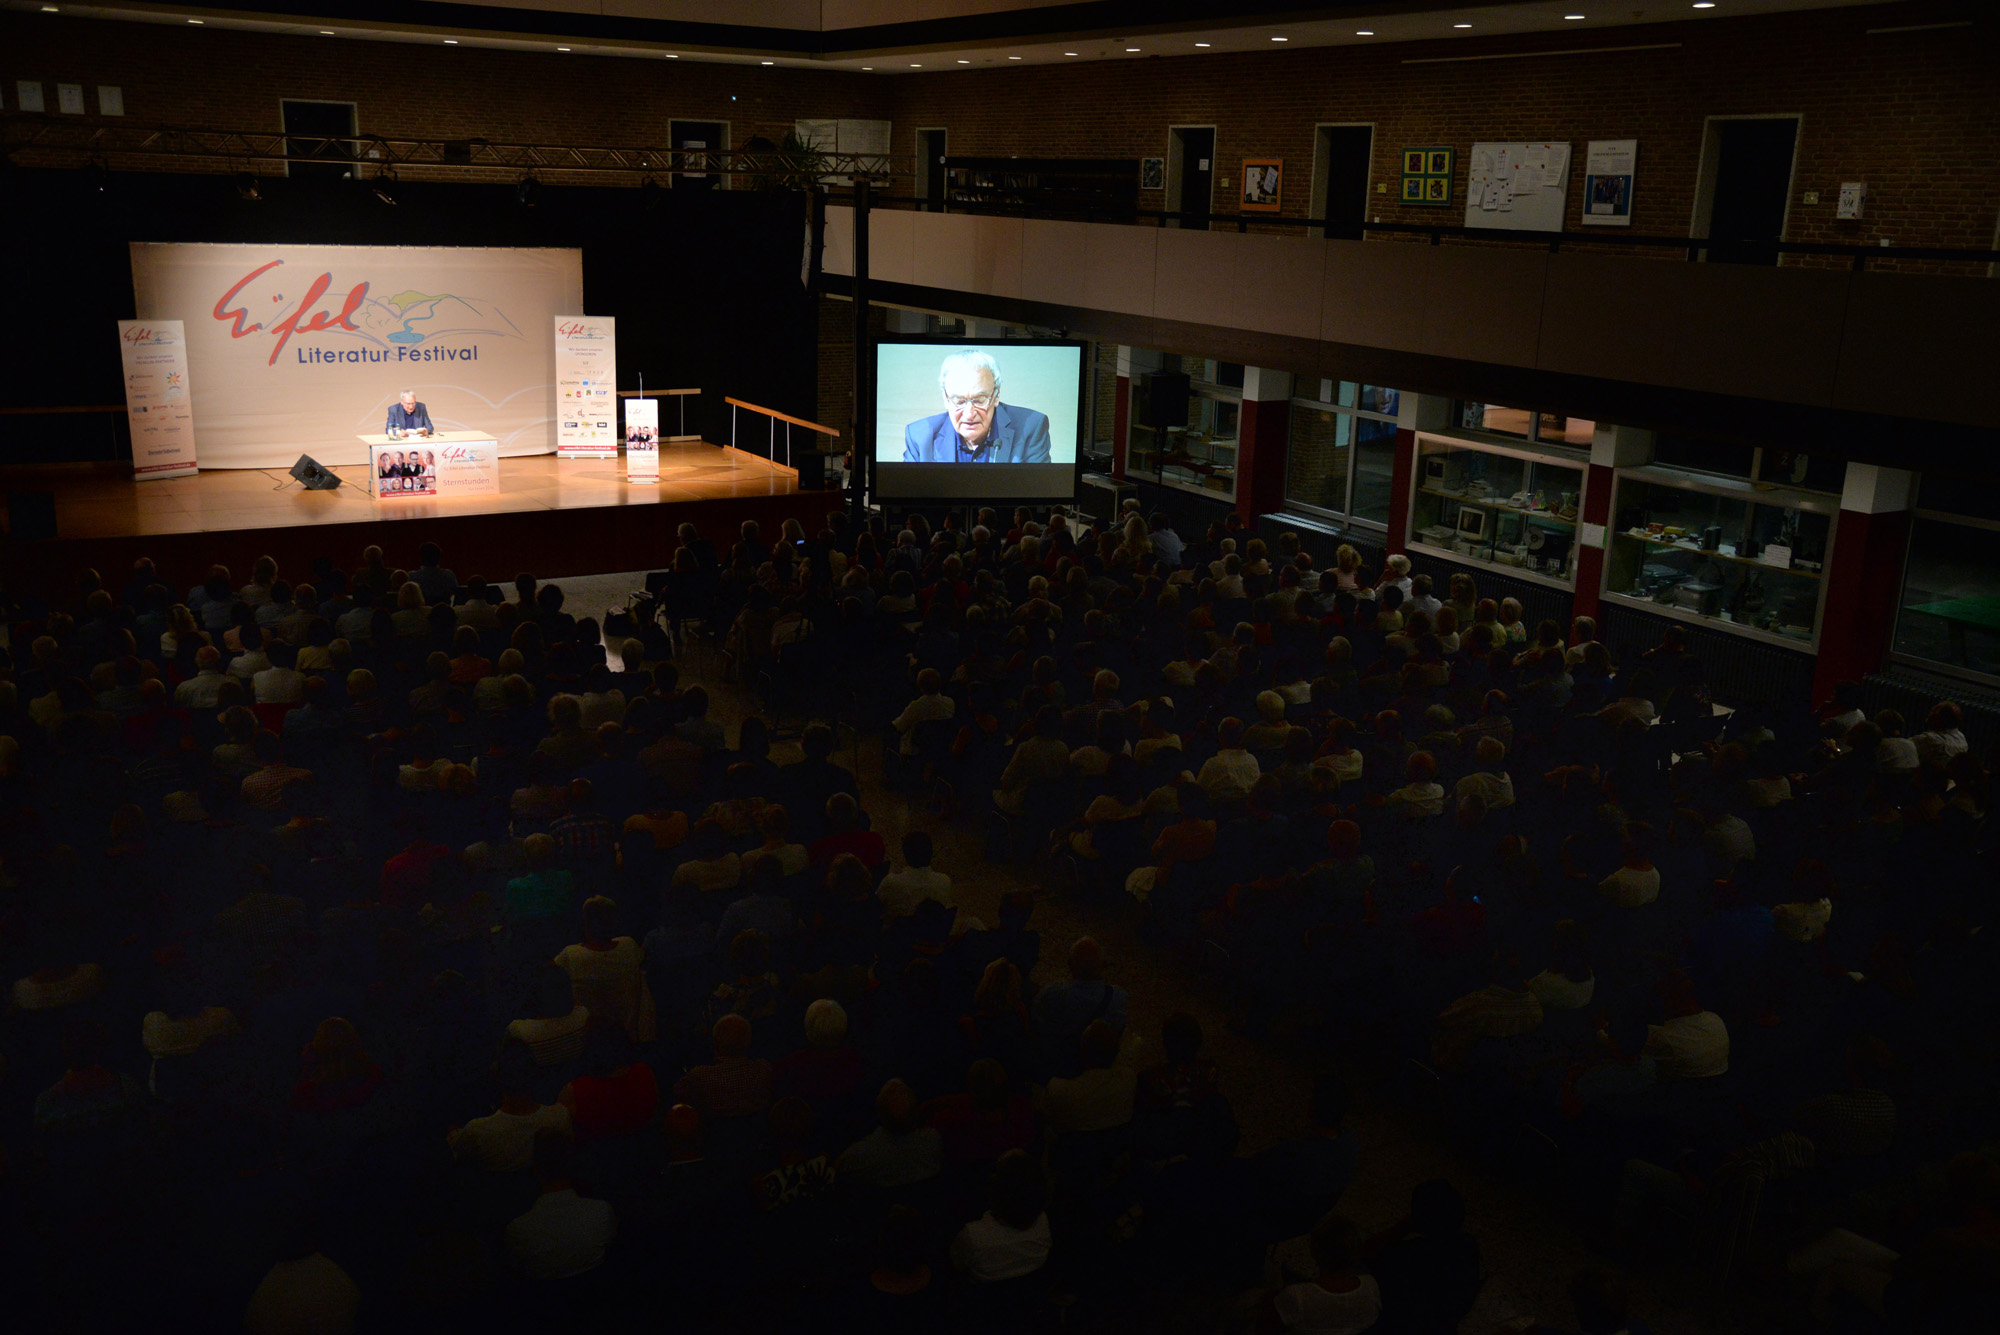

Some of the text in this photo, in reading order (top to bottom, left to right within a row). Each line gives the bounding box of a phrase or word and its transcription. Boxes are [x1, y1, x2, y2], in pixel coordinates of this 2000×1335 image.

[213, 259, 370, 366] Eifel
[297, 345, 478, 364] Literatur Festival
[442, 478, 490, 486] Sternstunden
